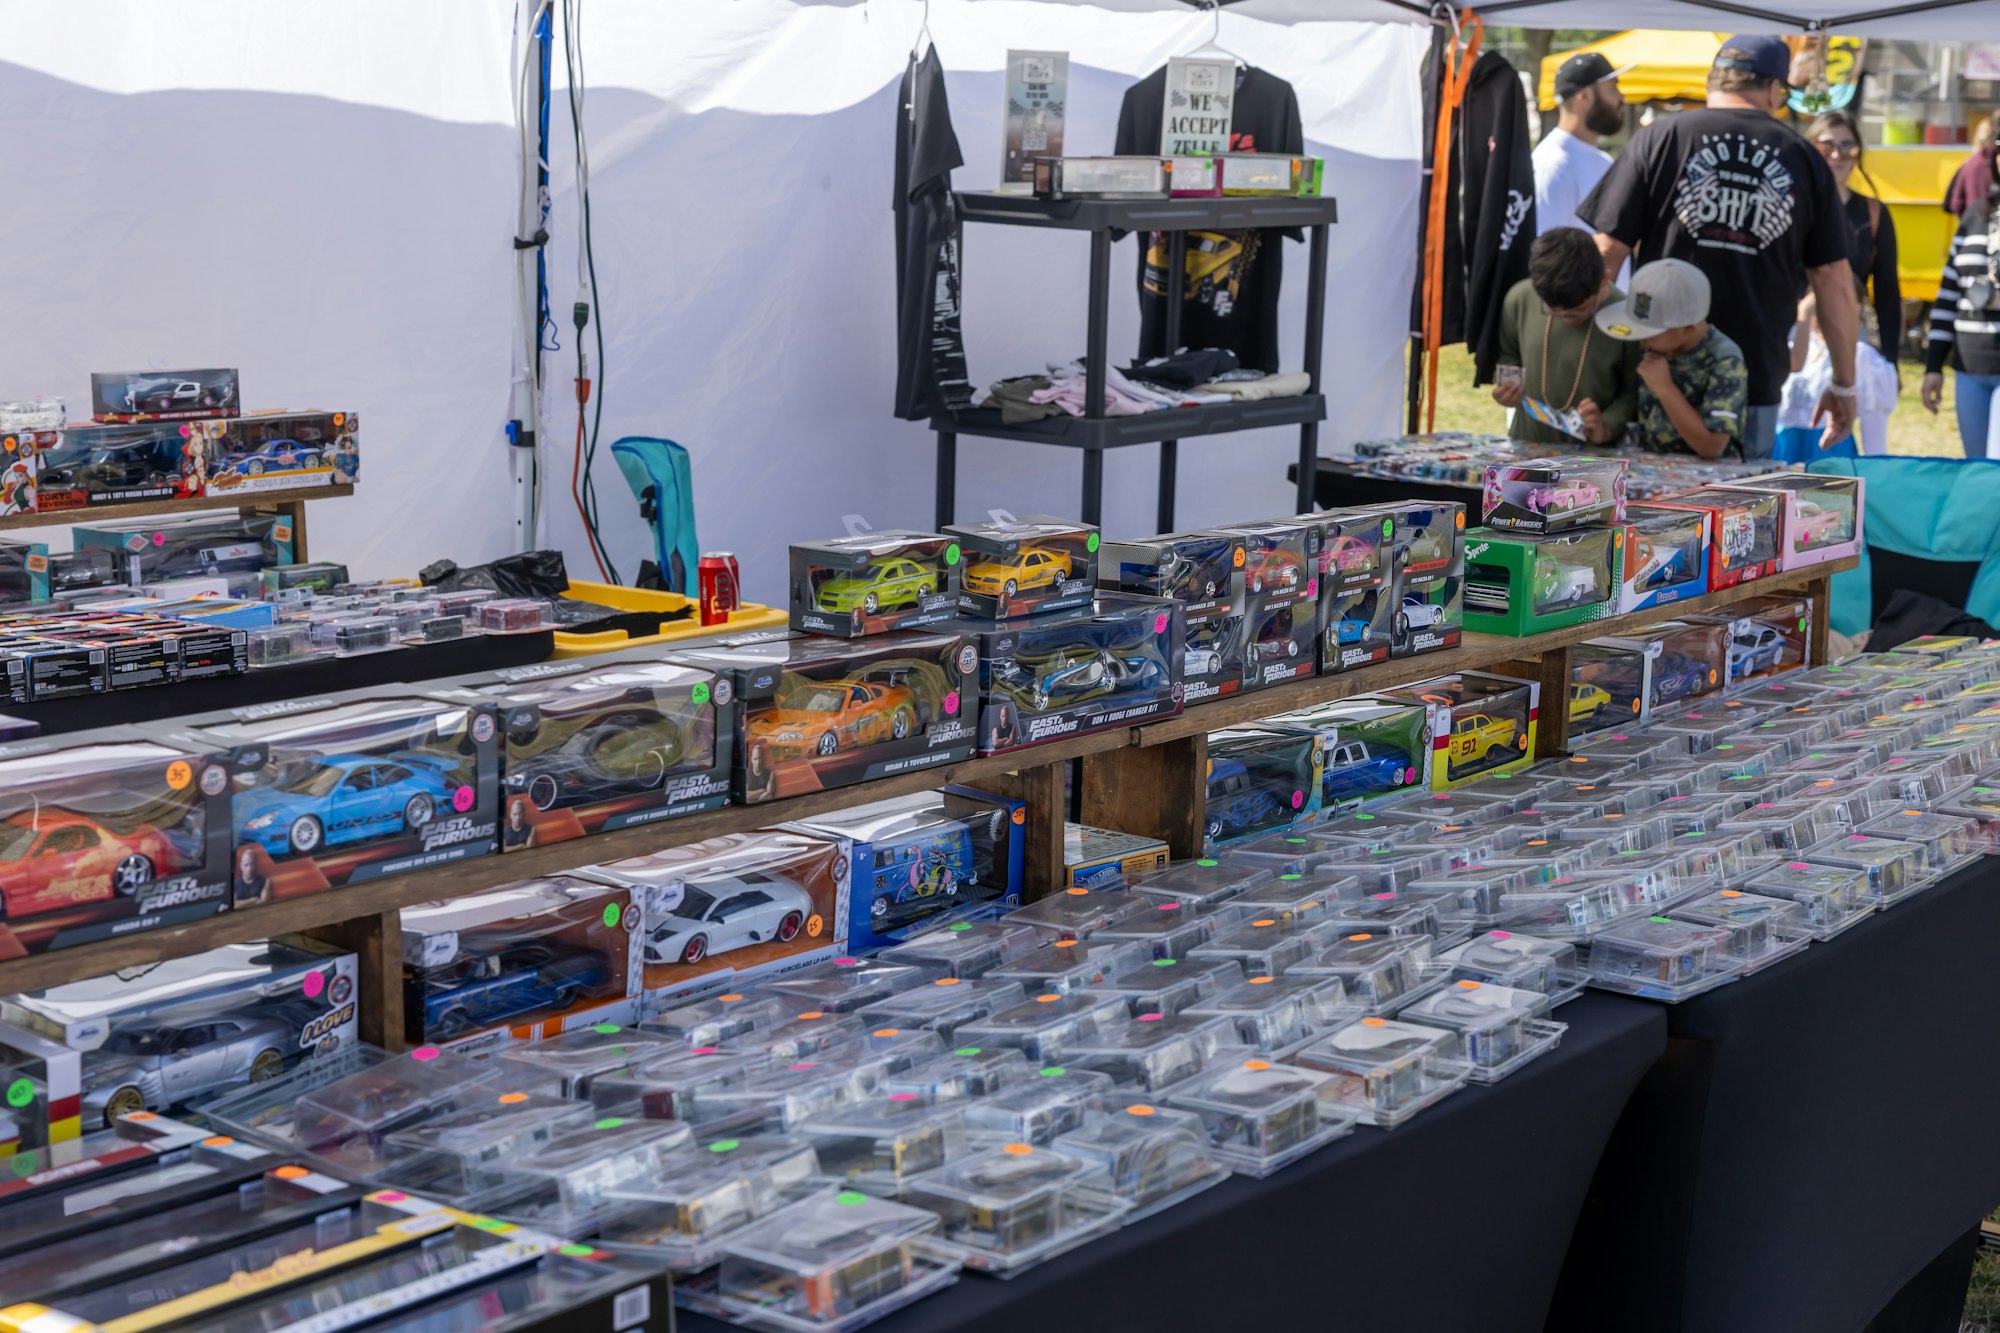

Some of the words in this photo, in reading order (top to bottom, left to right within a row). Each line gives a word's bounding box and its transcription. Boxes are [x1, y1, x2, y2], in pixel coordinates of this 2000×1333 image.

[1189, 94, 1213, 112] WE
[1168, 116, 1230, 136] ACCEPT
[1686, 142, 1731, 176] TOO
[1737, 142, 1792, 190] LOUD
[38, 493, 73, 502] TOKYO
[38, 500, 85, 509] REVENGERS
[1491, 516, 1511, 526] POWER
[1514, 518, 1544, 530] RANGERS
[1235, 551, 1244, 562] 25
[1464, 542, 1490, 561] Sprite
[1061, 585, 1094, 598] FURIOUS
[922, 599, 957, 613] FURIOUS
[803, 619, 836, 631] FURIOUS
[1413, 637, 1445, 653] FURIOUS
[1343, 652, 1373, 669] FURIOUS
[1265, 667, 1297, 685] FURIOUS
[1184, 686, 1221, 702] FURIOUS
[1108, 710, 1126, 722] DODGE
[1125, 705, 1149, 719] CHARGER
[1148, 703, 1159, 712] R/T
[928, 725, 977, 748] FURIOUS
[1031, 720, 1079, 742] FURIOUS
[1461, 737, 1477, 757] 91
[884, 761, 902, 773] BRIAN
[909, 756, 930, 768] TOYOTA
[930, 752, 951, 764] SUPRA
[666, 779, 730, 806] FURIOUS
[649, 810, 669, 820] DODGE
[668, 807, 686, 817] VIPER
[423, 822, 497, 853] FURIOUS
[138, 882, 227, 915] FURIOUS
[111, 920, 141, 934] MAZDA
[813, 957, 821, 965] LP
[302, 1024, 313, 1045] I
[311, 1001, 356, 1040] LOVE
